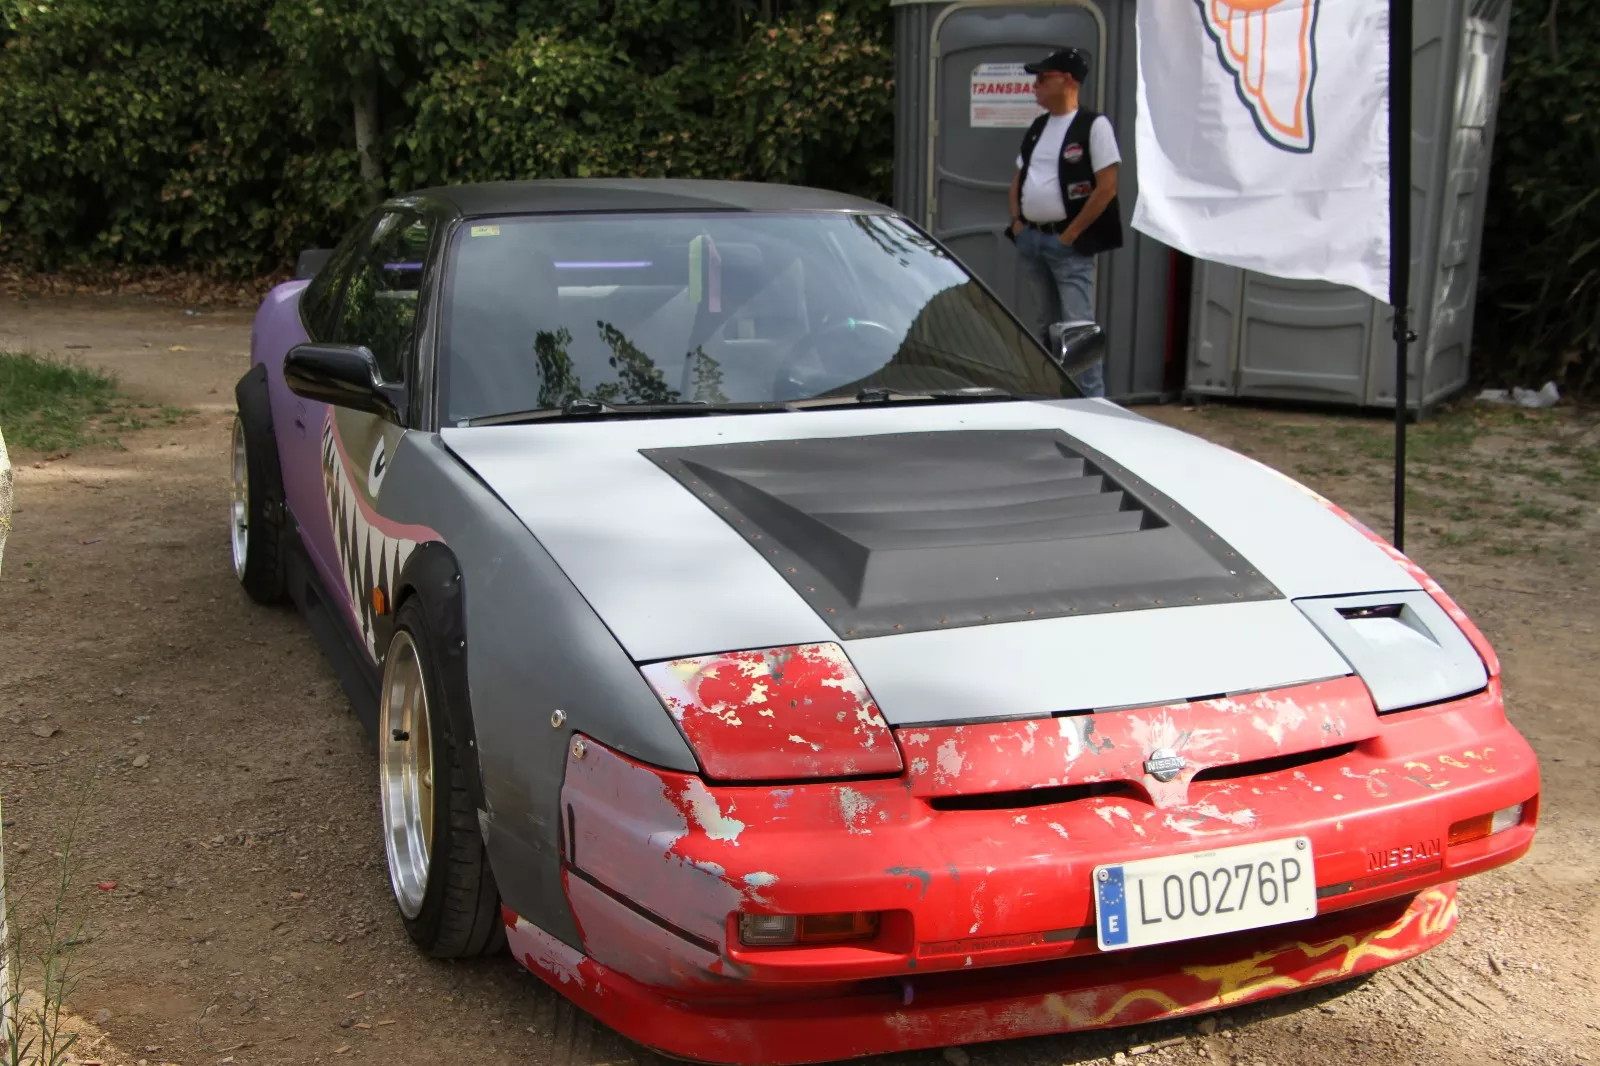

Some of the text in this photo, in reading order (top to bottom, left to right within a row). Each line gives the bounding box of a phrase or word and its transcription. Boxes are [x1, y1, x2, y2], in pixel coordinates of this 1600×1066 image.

[1147, 756, 1185, 771] NISSAN
[1366, 838, 1440, 872] NISSAN
[1138, 857, 1301, 925] L00276P
[1108, 915, 1120, 933] E
